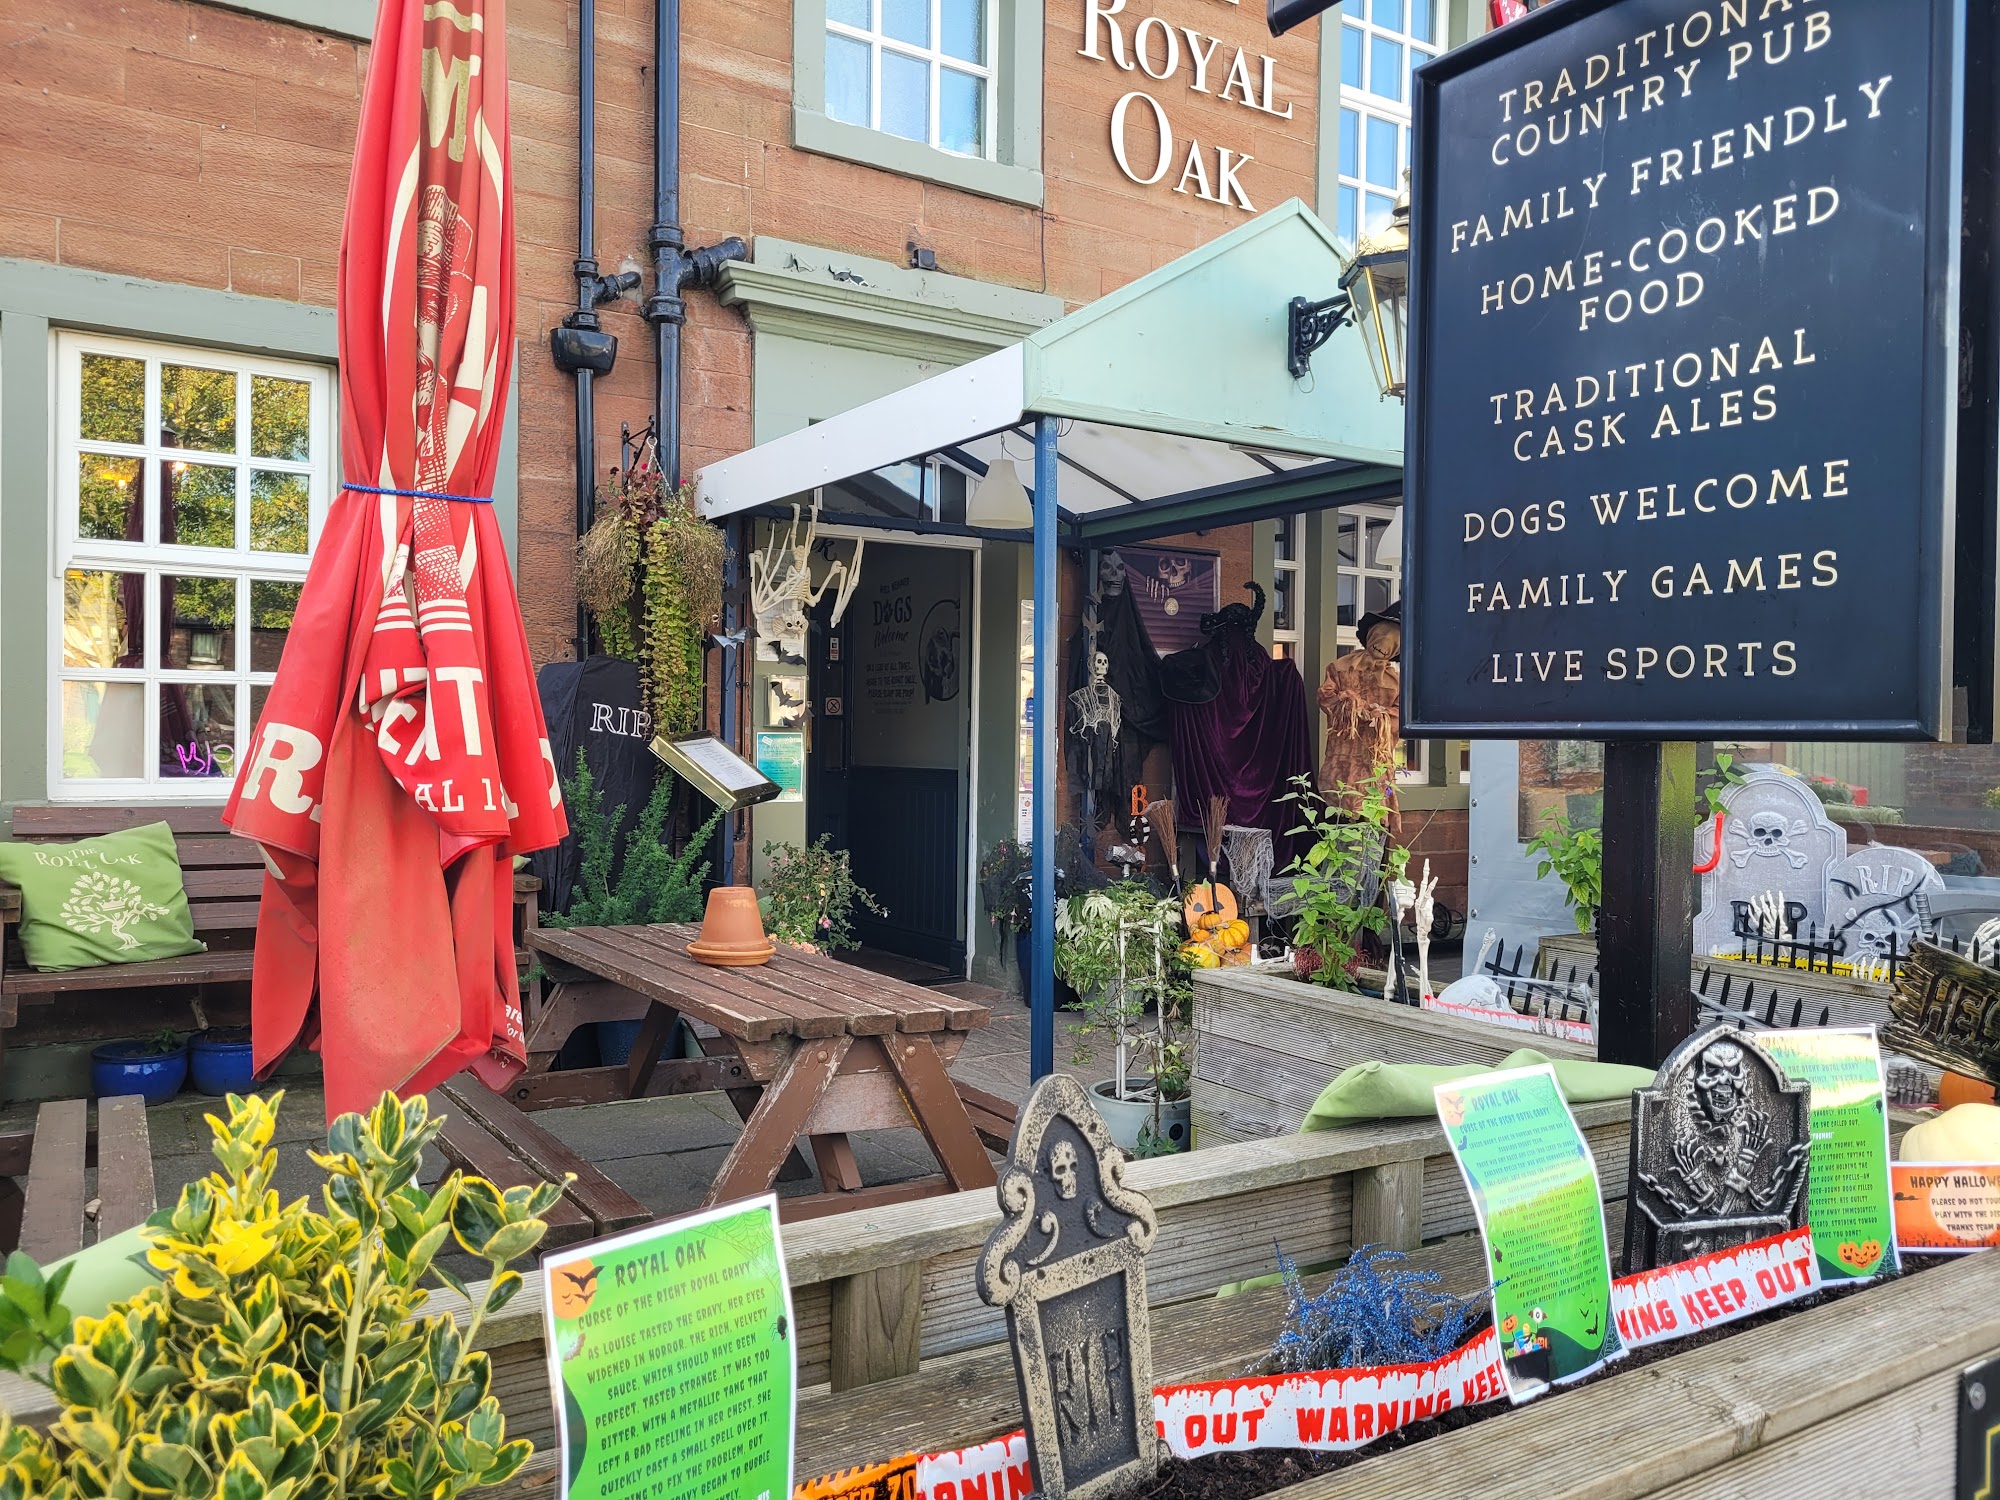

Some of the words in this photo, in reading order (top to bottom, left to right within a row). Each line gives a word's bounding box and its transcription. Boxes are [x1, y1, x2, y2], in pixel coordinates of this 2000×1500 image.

[1076, 0, 1292, 119] ROYAL
[1492, 60, 1700, 165] COUNTRY
[1727, 12, 1831, 80] PUB
[1110, 91, 1258, 213] OAK
[1450, 173, 1606, 253] FAMILY
[1630, 76, 1892, 195] FRIENDLY
[1480, 186, 1839, 314] HOME-COOKED
[1580, 272, 1704, 331] FOOD
[1490, 329, 1816, 424] TRADITIONAL
[1515, 413, 1626, 461] CASK
[1652, 385, 1777, 438] ALES
[1464, 500, 1566, 542] DOGS
[1591, 460, 1849, 525] WELCOME
[1468, 570, 1627, 612] FAMILY
[1652, 550, 1838, 598] GAMES
[1492, 650, 1583, 683] LIVE
[1607, 641, 1797, 680] SPORTS
[32, 852, 97, 870] ROYL
[1856, 864, 1915, 897] RIP
[1731, 901, 1808, 935] RP
[1471, 1093, 1501, 1111] ROYAL
[1503, 1089, 1521, 1106] OAK
[1910, 1176, 1949, 1188] HAPPY
[1932, 1198, 1956, 1206] PLEASE
[615, 1250, 669, 1288] ROYAL
[675, 1238, 707, 1268] OAK
[578, 1307, 612, 1330] CURSE
[617, 1301, 629, 1317] OF
[633, 1294, 653, 1311] THE
[656, 1283, 687, 1304] RIGHT
[691, 1272, 720, 1292] ROYAL
[722, 1261, 751, 1281] GRAVY
[588, 1346, 599, 1360] AS
[602, 1333, 637, 1355] LOUISE
[640, 1320, 673, 1341] TASTED
[676, 1314, 693, 1329] THE
[728, 1295, 744, 1310] HER
[746, 1288, 765, 1304] EYES
[1616, 1299, 1678, 1341] NING
[1680, 1278, 1747, 1328] KEEP
[1755, 1258, 1810, 1299] OUT
[587, 1363, 631, 1385] WIDENED
[634, 1354, 645, 1368] IN
[690, 1333, 706, 1346] THE
[734, 1307, 768, 1328] VELVETY
[643, 1367, 673, 1386] WHICH
[677, 1352, 709, 1374] SHOULD
[712, 1342, 733, 1359] HAVE
[736, 1332, 756, 1350] BEEN
[642, 1387, 676, 1410] TASTED
[722, 1363, 732, 1377] IT
[735, 1356, 752, 1372] WAS
[755, 1349, 770, 1364] TOO
[642, 1412, 667, 1432] WITH
[670, 1409, 676, 1421] A
[679, 1390, 720, 1417] METALLIC
[724, 1382, 745, 1399] TANG
[748, 1370, 768, 1387] THAT
[1463, 1359, 1508, 1405] KEE
[598, 1455, 620, 1475] LEFT
[624, 1451, 630, 1464] A
[634, 1442, 651, 1459] BAD
[655, 1424, 691, 1449] FEELING
[694, 1418, 704, 1431] IN
[708, 1411, 724, 1427] HER
[757, 1389, 772, 1405] SHE
[1185, 1408, 1265, 1449] OUT
[1296, 1390, 1451, 1443] WARNING
[601, 1468, 642, 1496] QUICKLY
[646, 1456, 668, 1477] CAST
[672, 1452, 678, 1465] A
[681, 1439, 708, 1461] SMALL
[711, 1427, 734, 1447] SPELL
[737, 1417, 757, 1436] OVER
[651, 1482, 663, 1496] TO
[667, 1472, 682, 1490] FIX
[686, 1463, 702, 1480] THE
[748, 1433, 763, 1450] BUT
[701, 1472, 727, 1495] BEGAN
[731, 1466, 740, 1480] TO
[744, 1449, 770, 1474] BUBBLE
